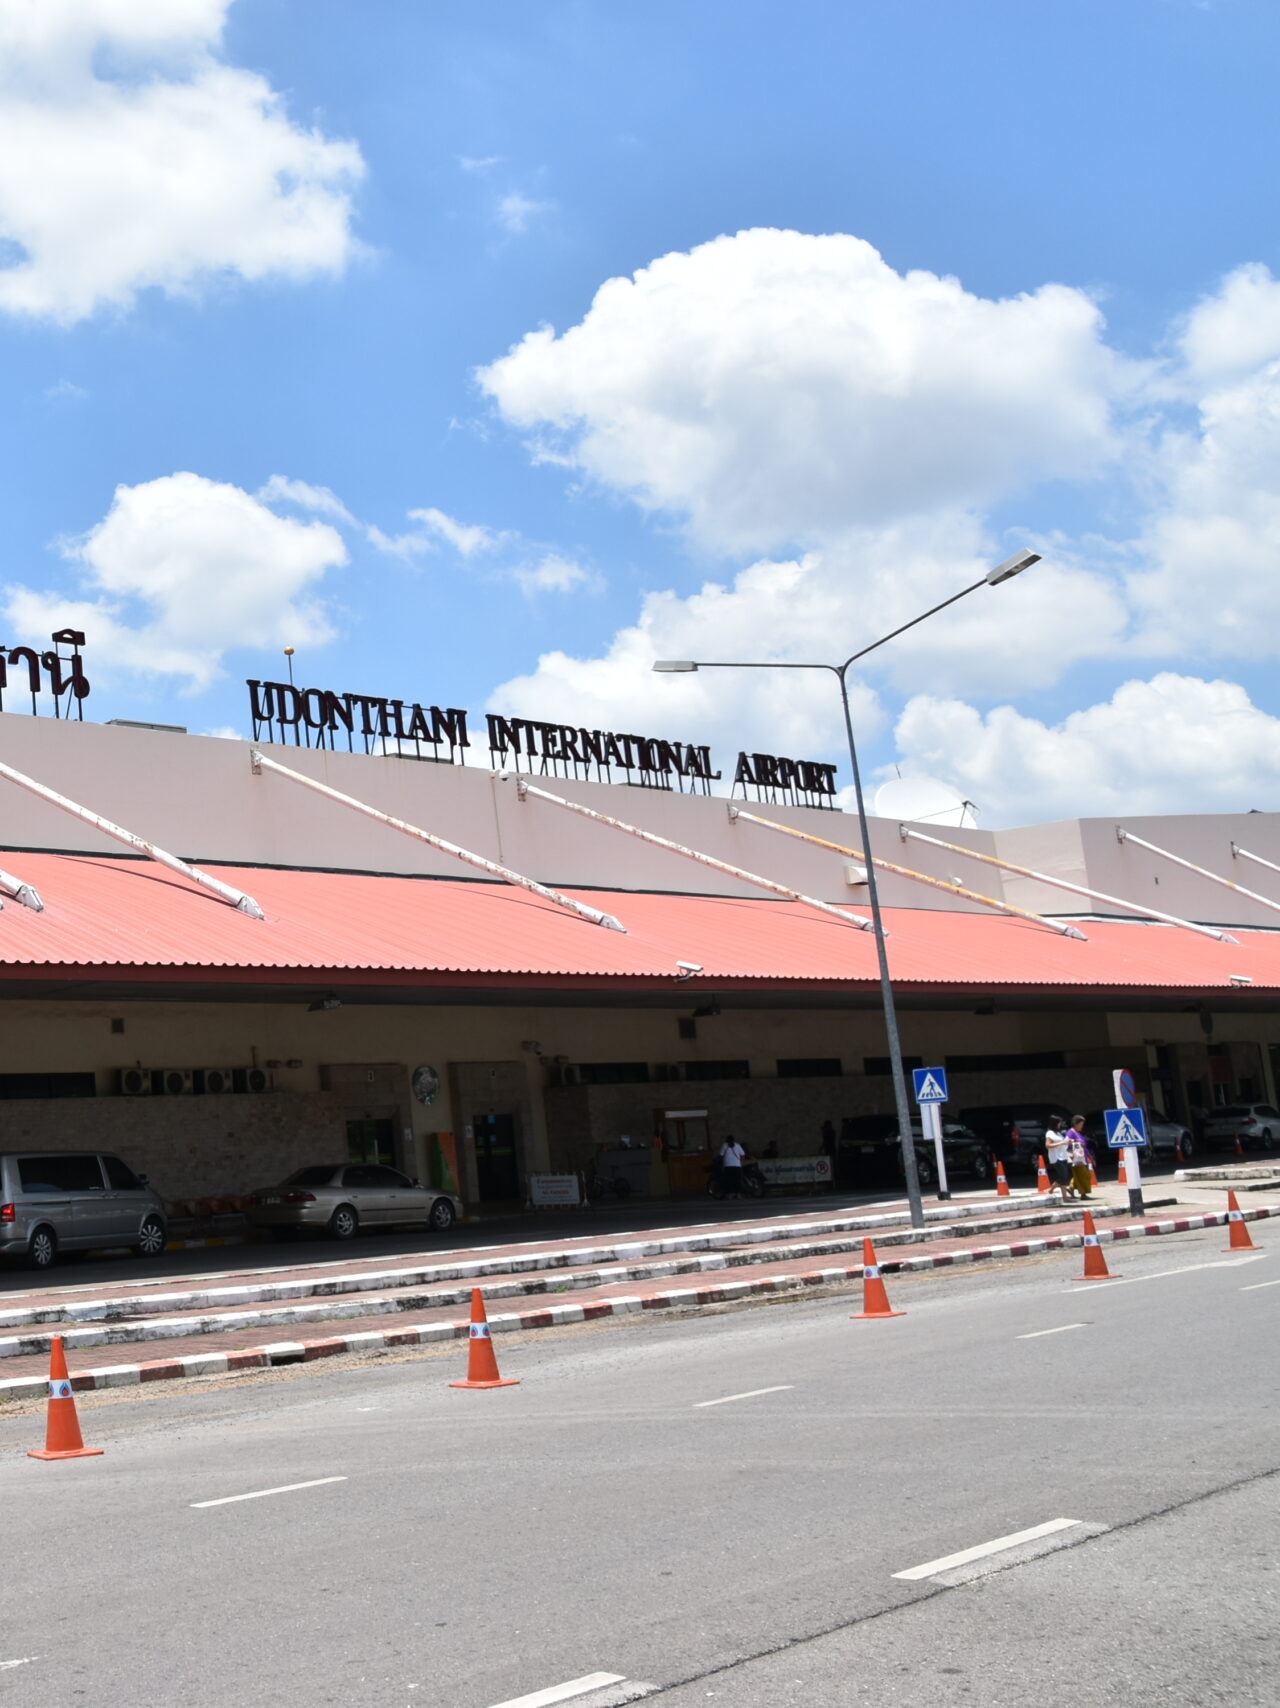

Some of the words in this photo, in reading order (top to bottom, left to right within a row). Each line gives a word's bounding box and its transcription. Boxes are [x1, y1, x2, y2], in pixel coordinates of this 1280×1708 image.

[246, 679, 471, 748] UDONTHANI
[485, 713, 722, 780] INTERNATIONAL
[735, 751, 838, 795] AIRPORT
